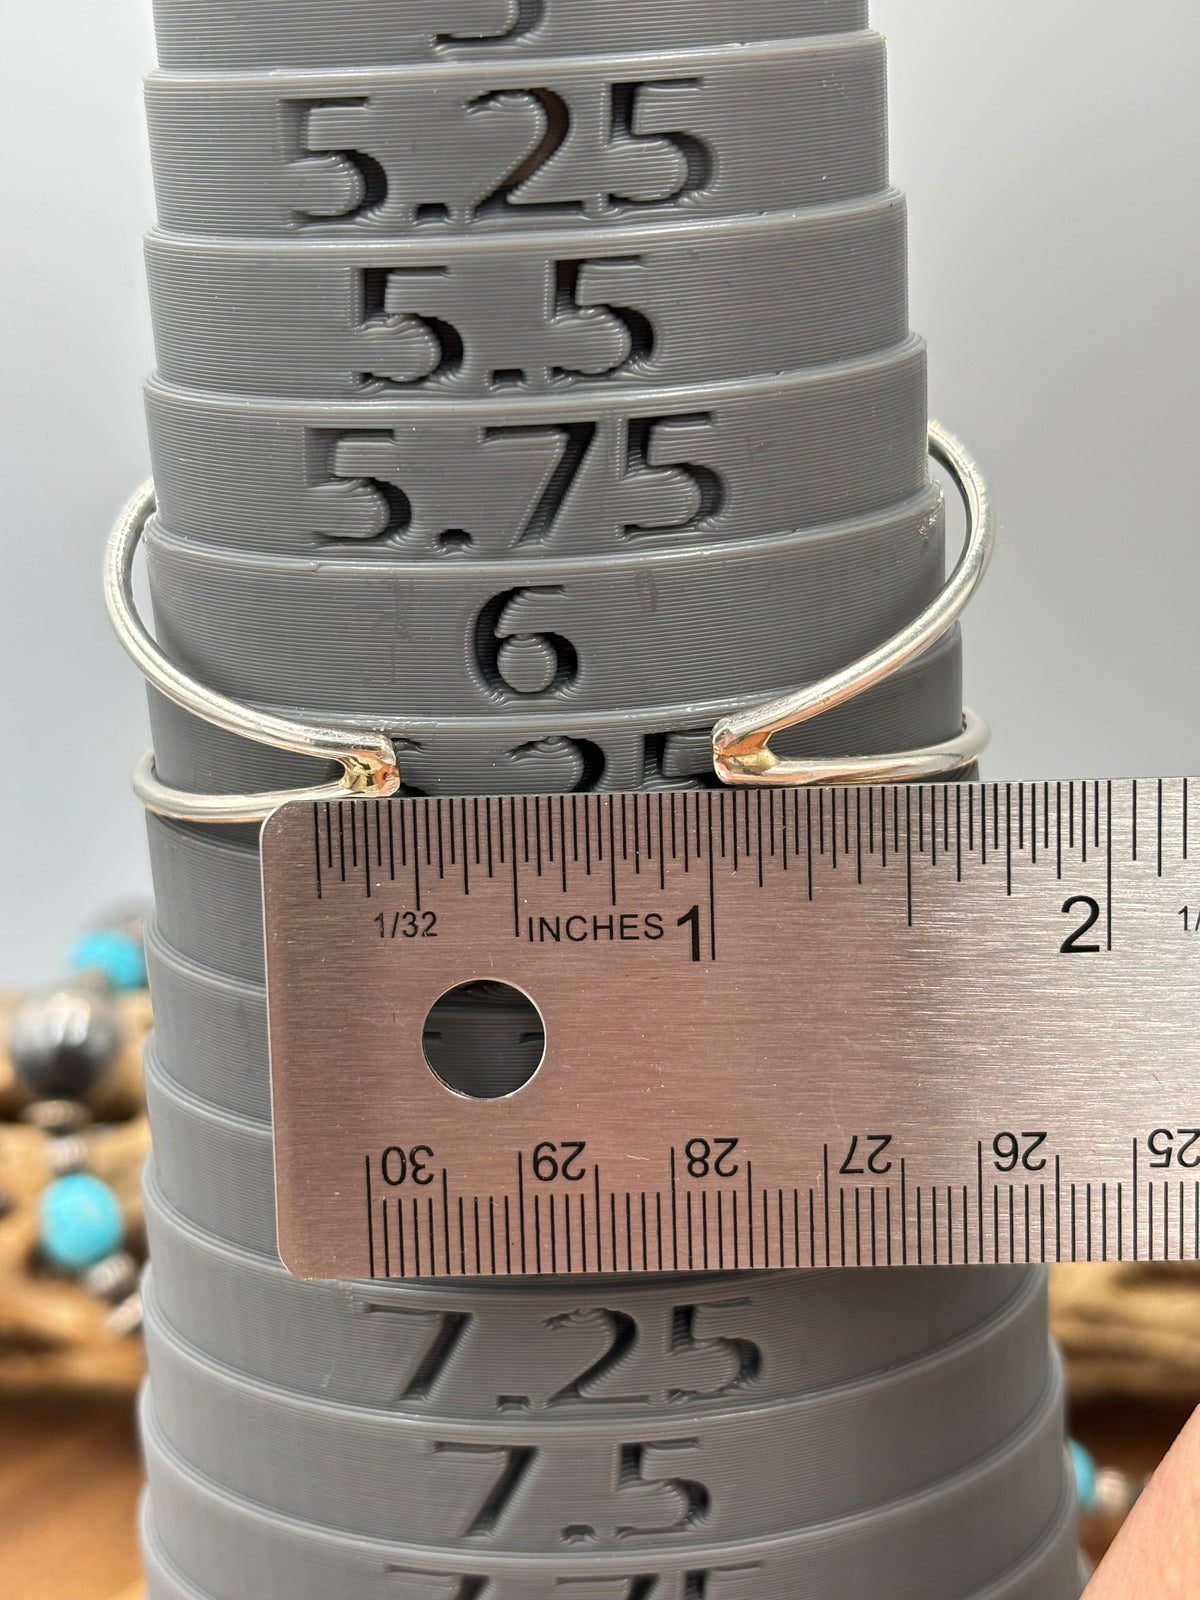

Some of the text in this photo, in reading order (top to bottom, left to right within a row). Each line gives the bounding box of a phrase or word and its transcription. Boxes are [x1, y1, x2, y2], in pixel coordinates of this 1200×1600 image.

[280, 77, 717, 230] 5.25
[354, 254, 658, 389] 5.5
[305, 411, 726, 554] 5.75
[470, 584, 580, 704] 6
[374, 910, 438, 939] 1/32
[528, 912, 665, 943] INCHES
[676, 904, 701, 962] 1
[1060, 895, 1100, 954] 2
[381, 1144, 434, 1186] 30
[532, 1141, 586, 1181] 29
[685, 1137, 739, 1178] 28
[838, 1134, 892, 1174] 27
[992, 1131, 1047, 1172] 26
[1147, 1128, 1200, 1168] 25
[365, 1297, 762, 1409] 7.25
[434, 1437, 710, 1544] 7.5
